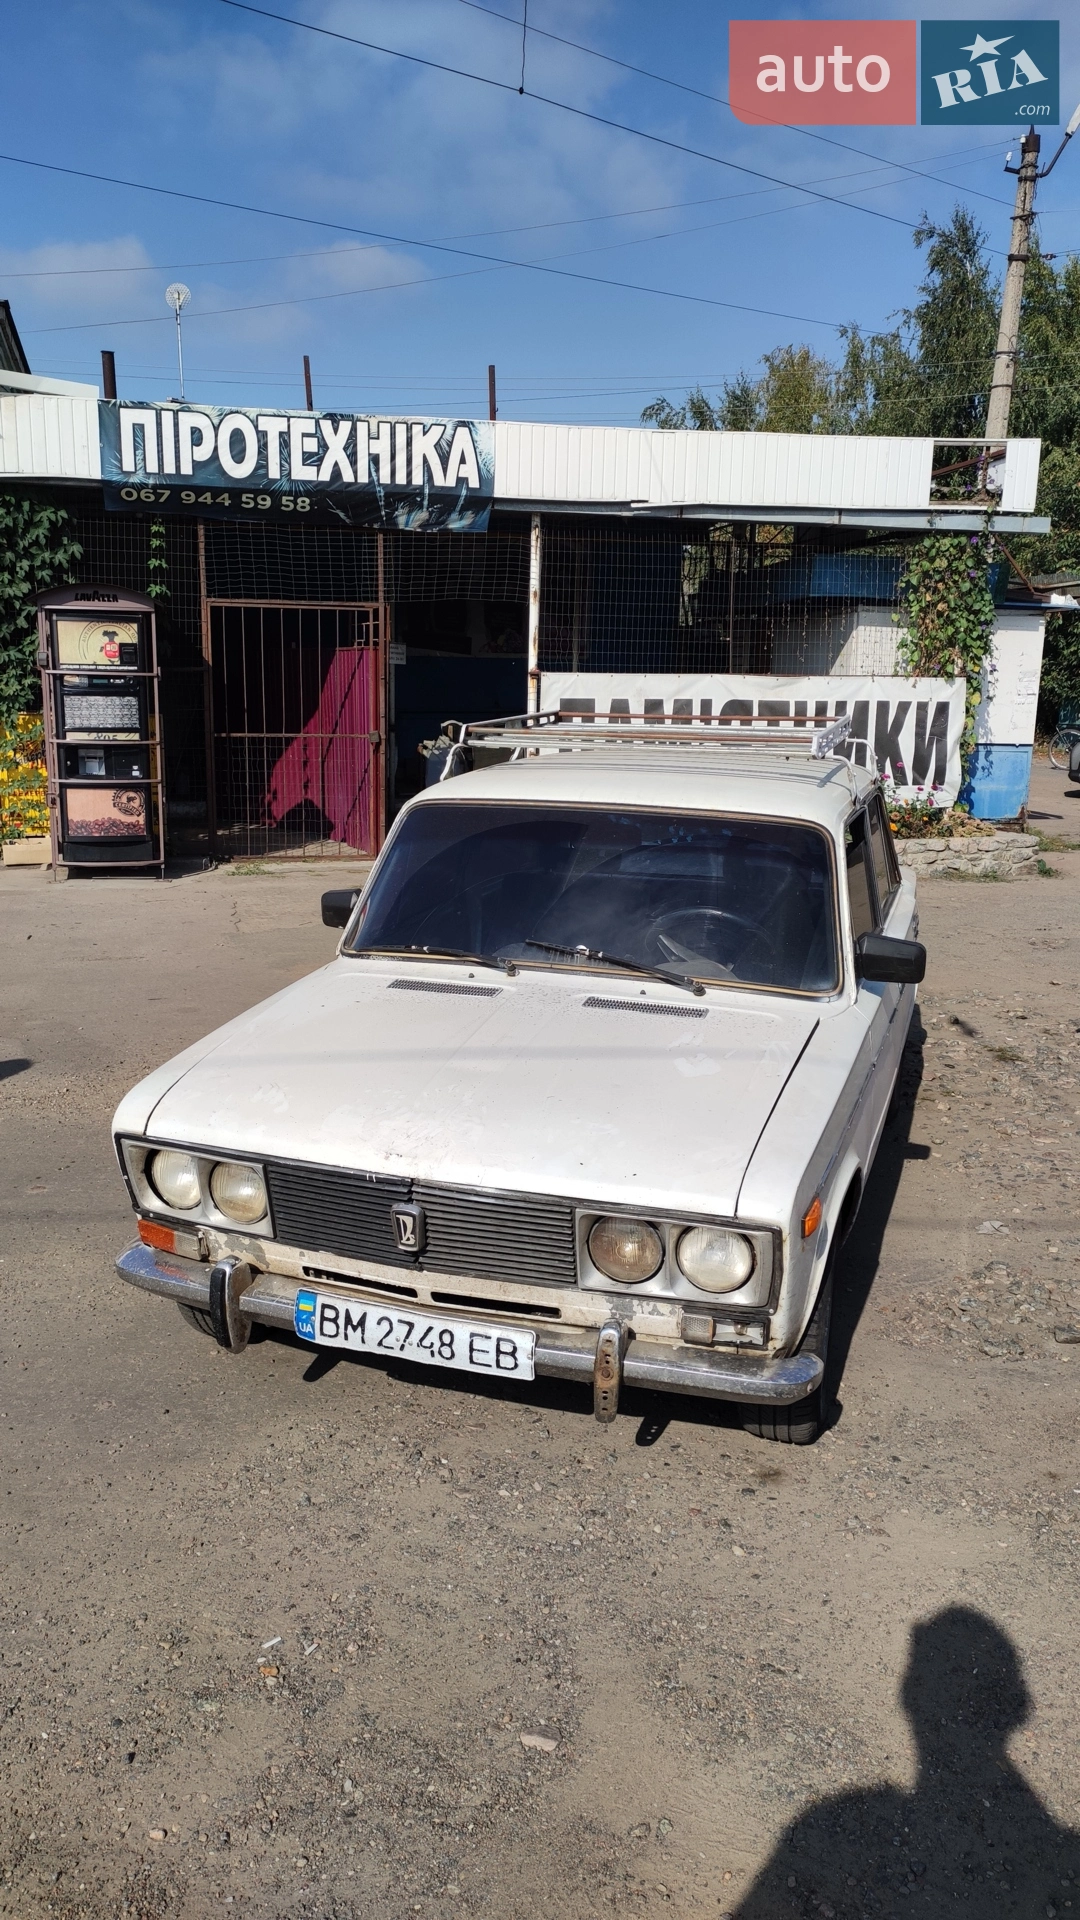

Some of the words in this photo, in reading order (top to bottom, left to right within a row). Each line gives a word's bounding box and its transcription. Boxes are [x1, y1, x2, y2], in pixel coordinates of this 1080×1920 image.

[118, 407, 481, 489] ПІРОТЕХНІКА
[120, 487, 171, 503] 067
[180, 490, 232, 507] 944
[240, 493, 272, 509] 59
[280, 496, 311, 512] 58
[299, 1323, 313, 1335] UA
[319, 1303, 367, 1344] BM
[376, 1316, 455, 1361] 2748
[469, 1332, 519, 1371] EB
